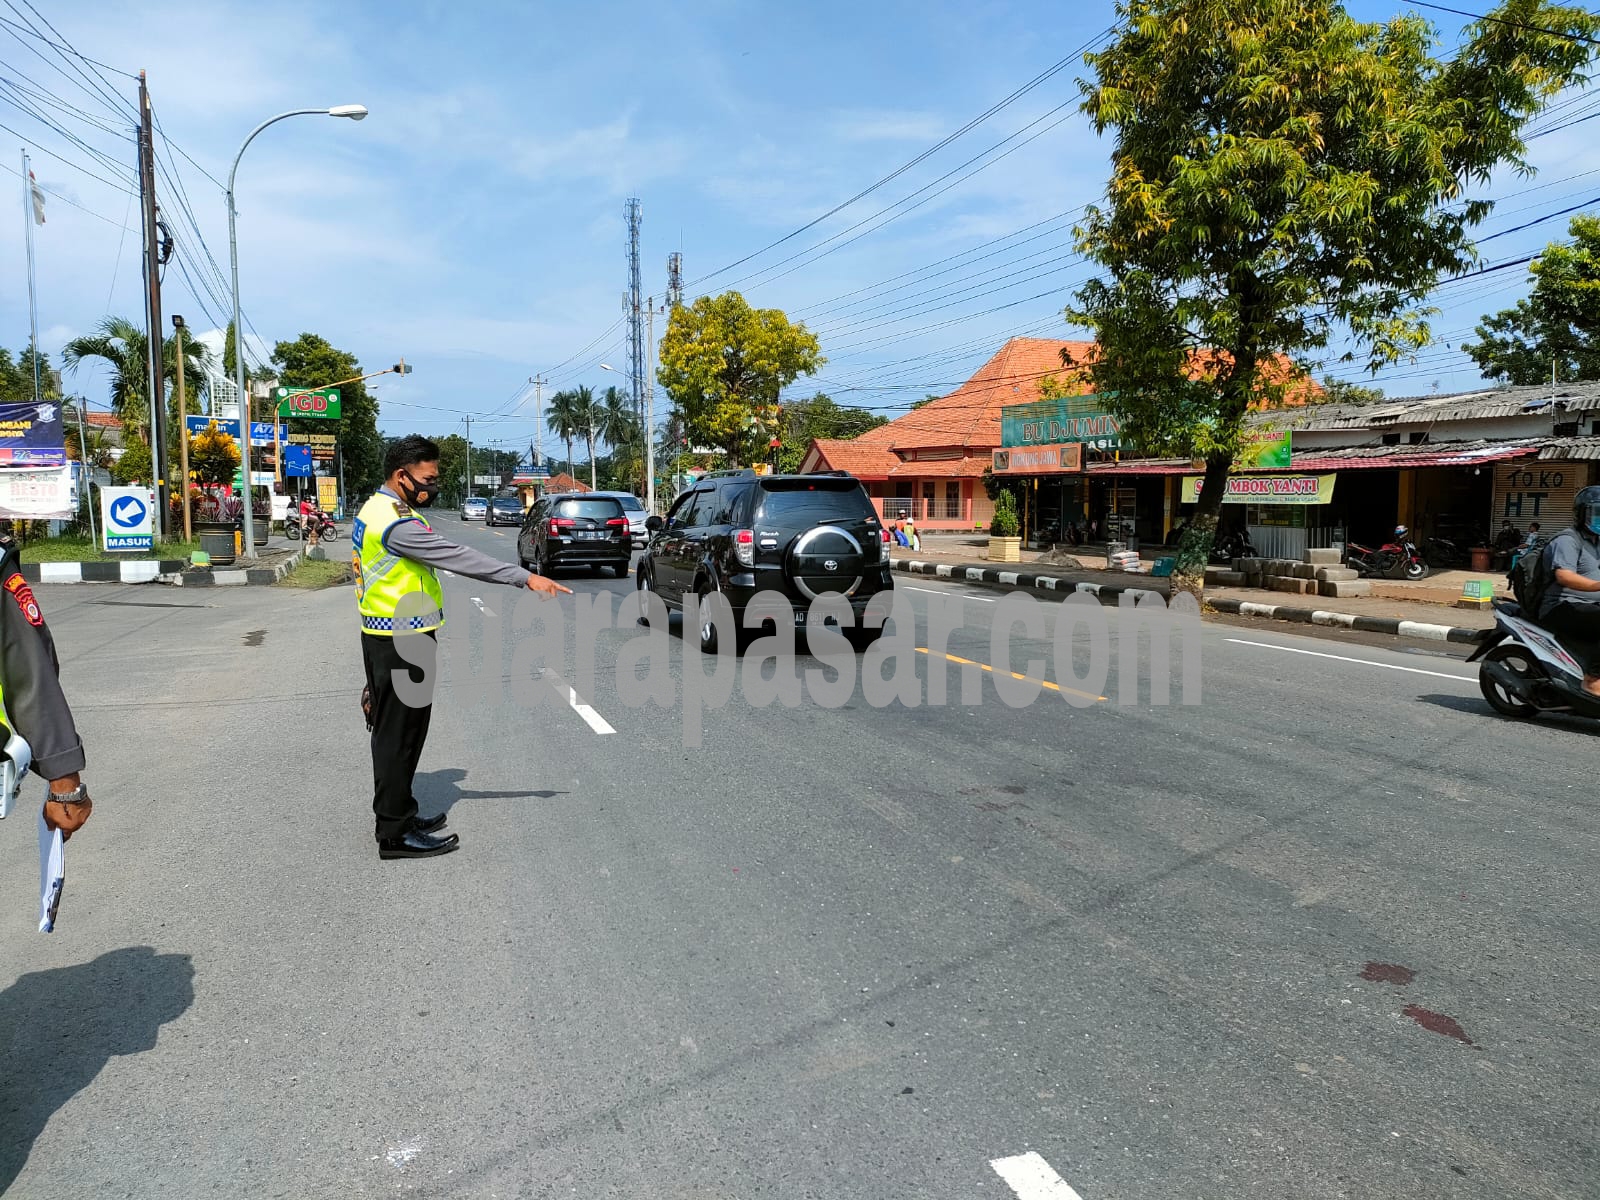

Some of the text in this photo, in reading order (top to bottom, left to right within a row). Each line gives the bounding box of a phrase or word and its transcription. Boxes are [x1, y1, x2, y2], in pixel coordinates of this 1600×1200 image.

[289, 395, 327, 411] IGD
[1022, 422, 1044, 442] BU
[1087, 438, 1122, 449] ASLI
[1040, 449, 1058, 465] JAWA
[1229, 478, 1270, 494] MBOK
[1271, 477, 1319, 494] YANTI
[1505, 493, 1548, 517] HT
[108, 537, 152, 547] MASUK
[795, 612, 804, 622] AD
